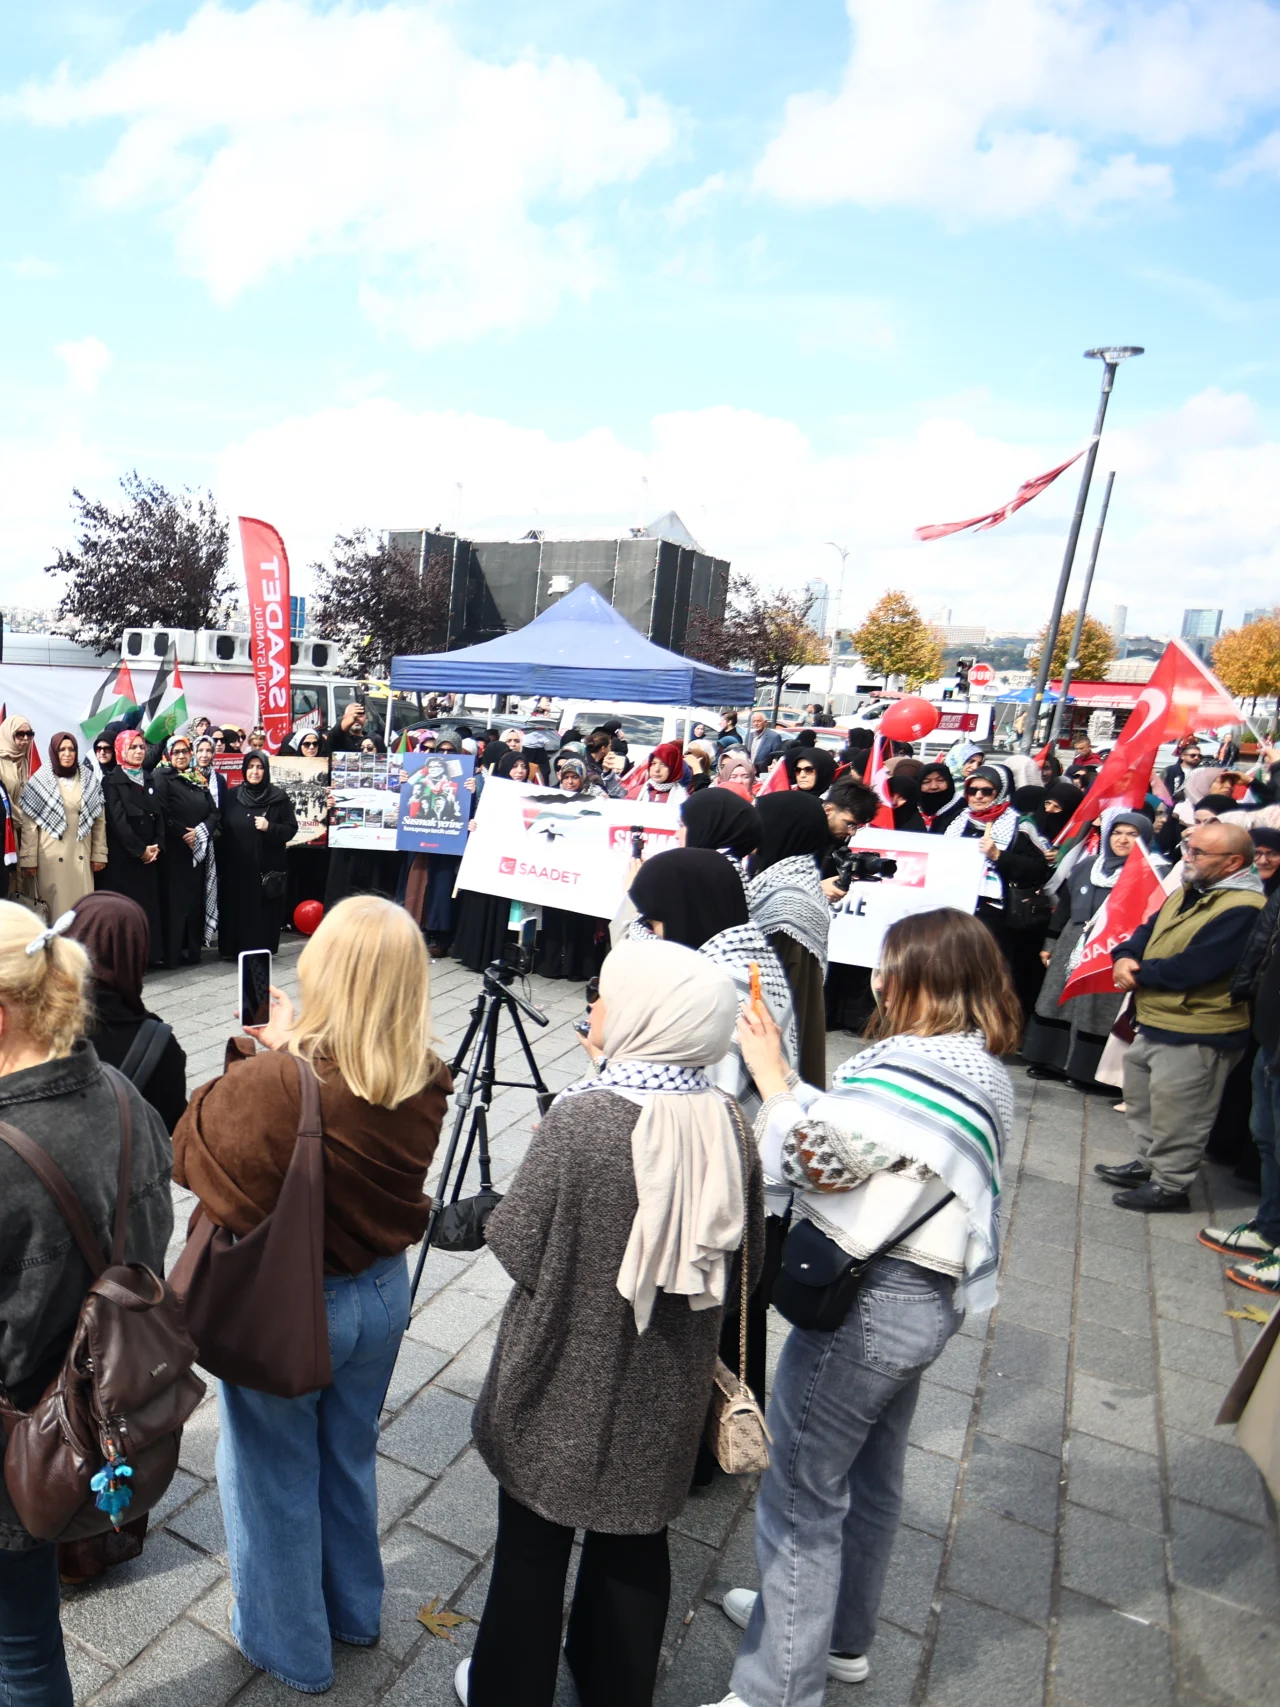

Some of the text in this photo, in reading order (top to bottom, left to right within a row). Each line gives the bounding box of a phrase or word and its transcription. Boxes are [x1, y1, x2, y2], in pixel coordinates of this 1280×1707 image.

[969, 671, 991, 681] DUR
[401, 815, 465, 829] Susmak yerine
[518, 862, 582, 885] SAADET
